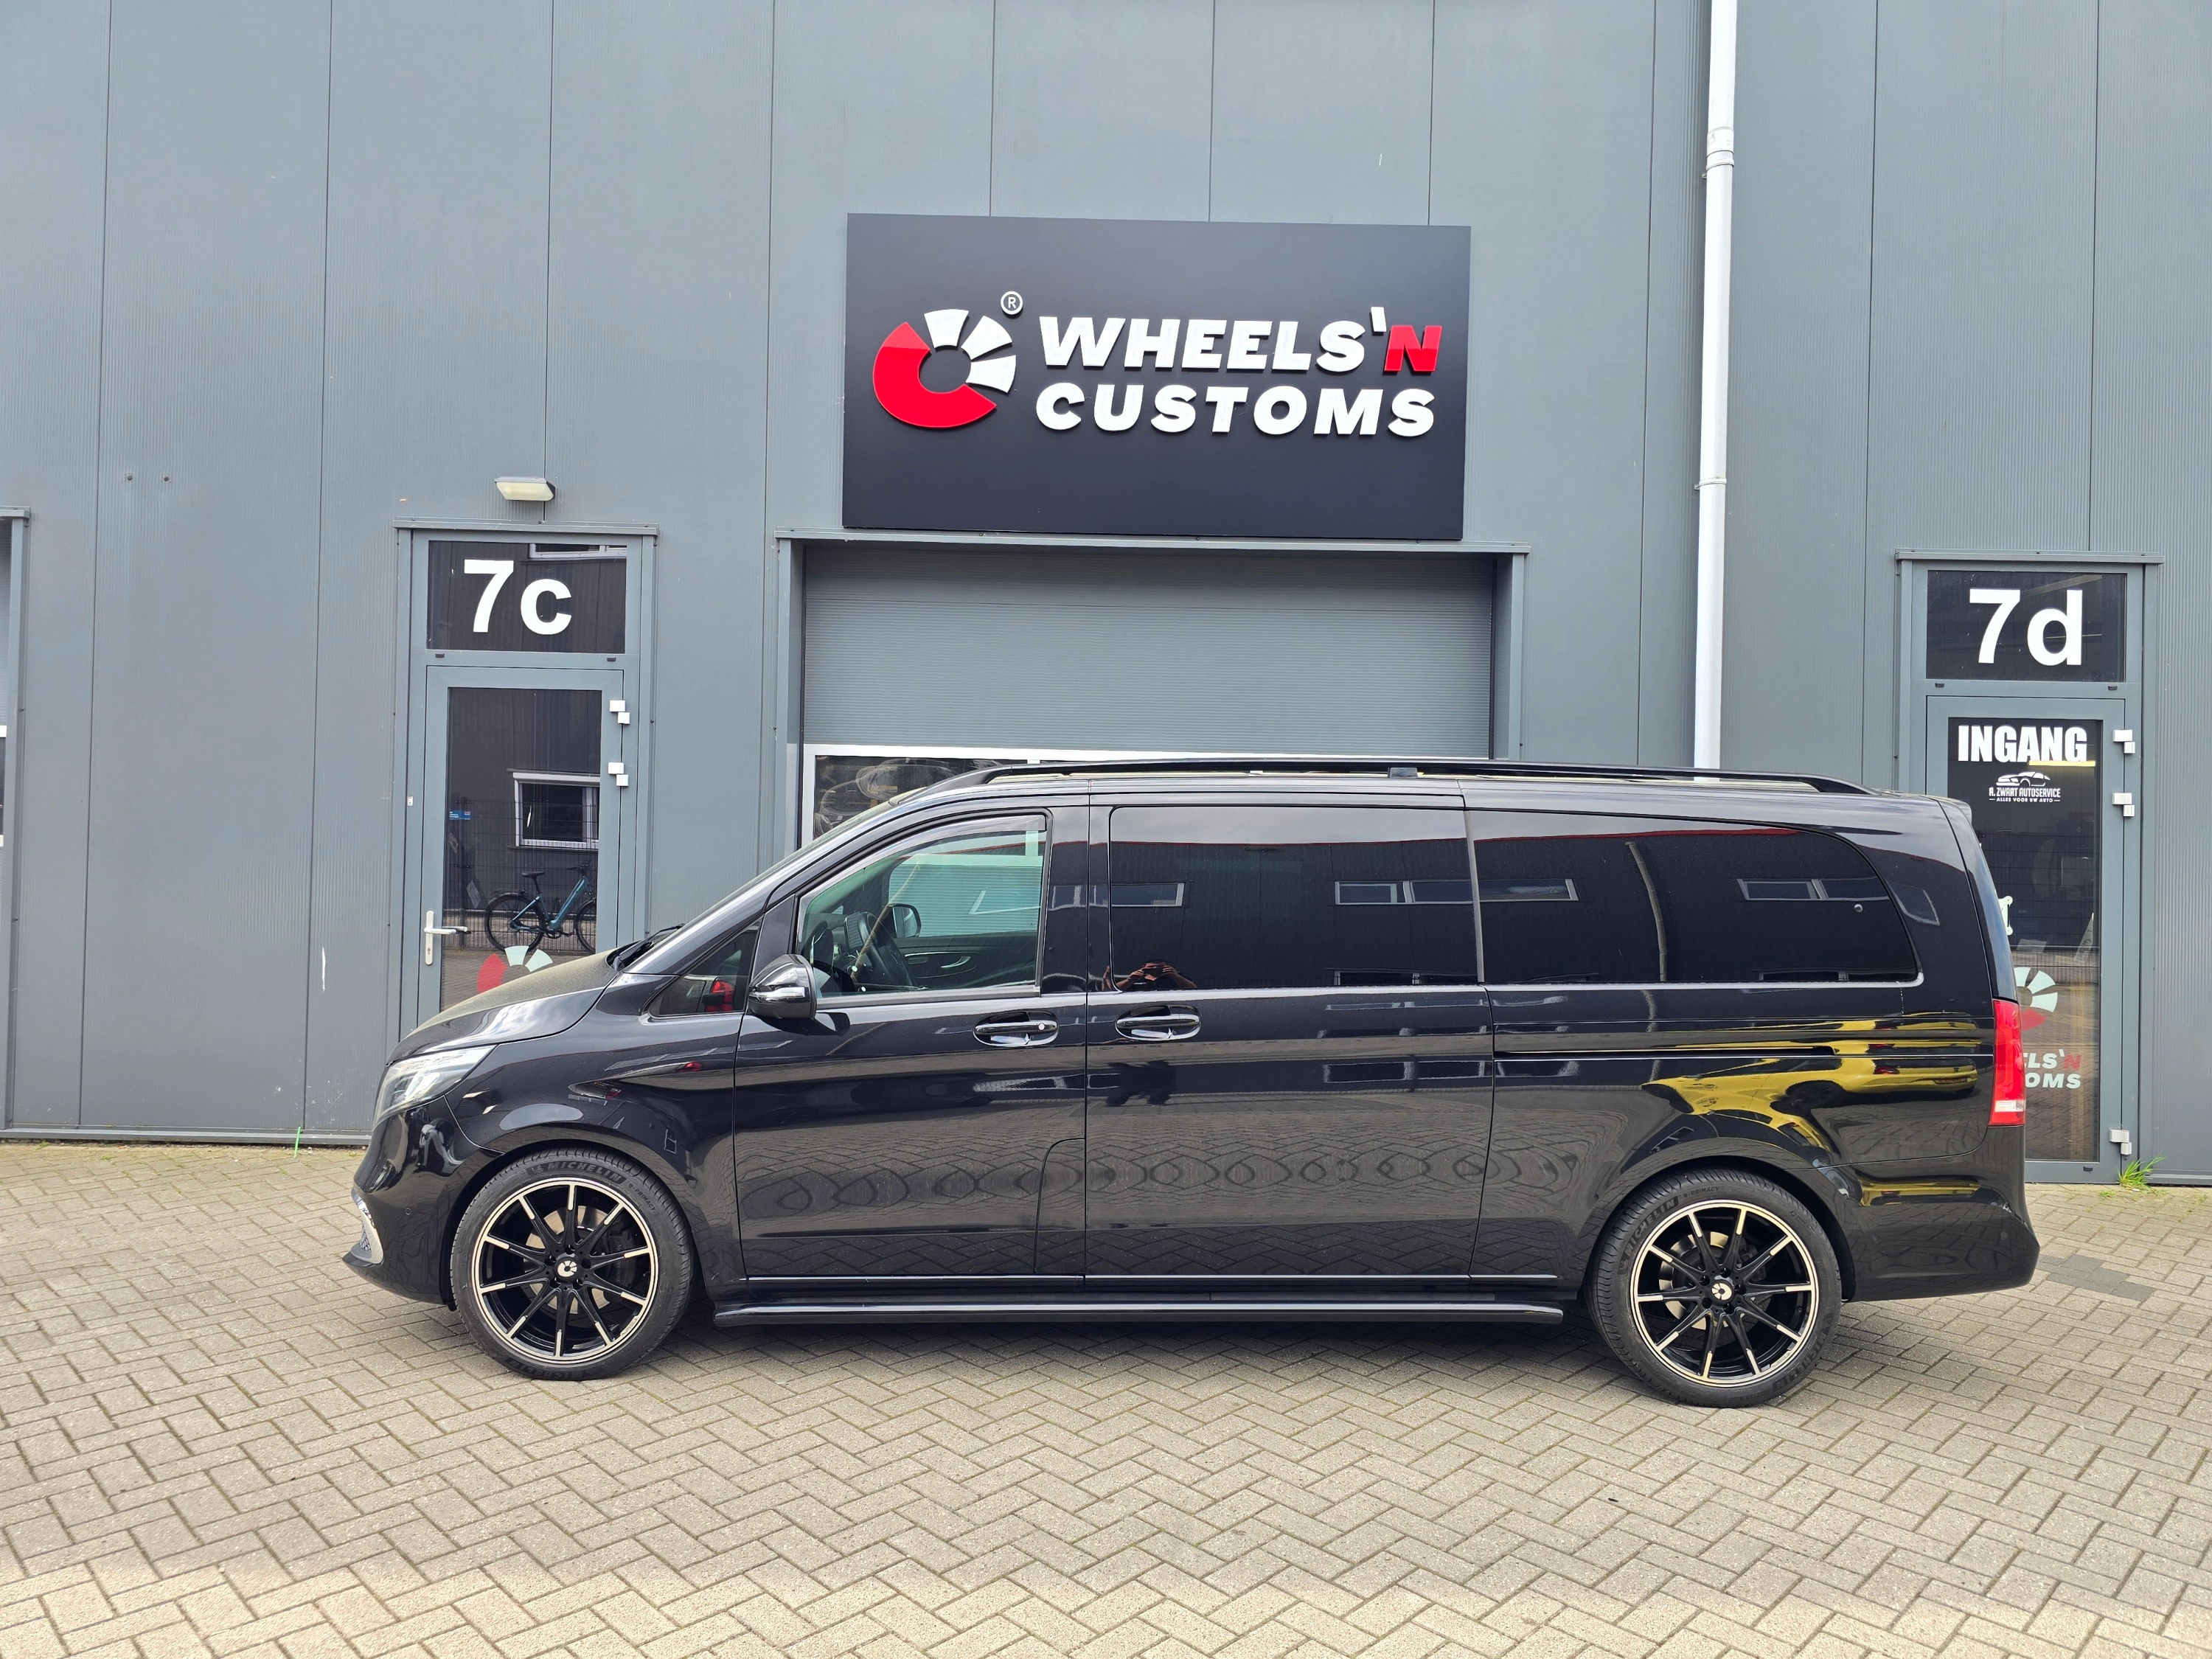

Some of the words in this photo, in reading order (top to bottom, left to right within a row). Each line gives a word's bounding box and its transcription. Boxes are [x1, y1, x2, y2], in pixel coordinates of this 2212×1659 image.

[1038, 306, 1442, 373] WHEELS'N
[1035, 381, 1436, 438] CUSTOMS
[464, 559, 572, 636] 7c
[1969, 588, 2083, 667] 7d
[1958, 725, 2087, 762] INGANG
[1996, 787, 2019, 797] ZWART
[2019, 787, 2061, 798] AUTOSERVICE
[547, 1161, 622, 1182] MICHELIN
[1624, 1198, 1676, 1258] MICHELIN
